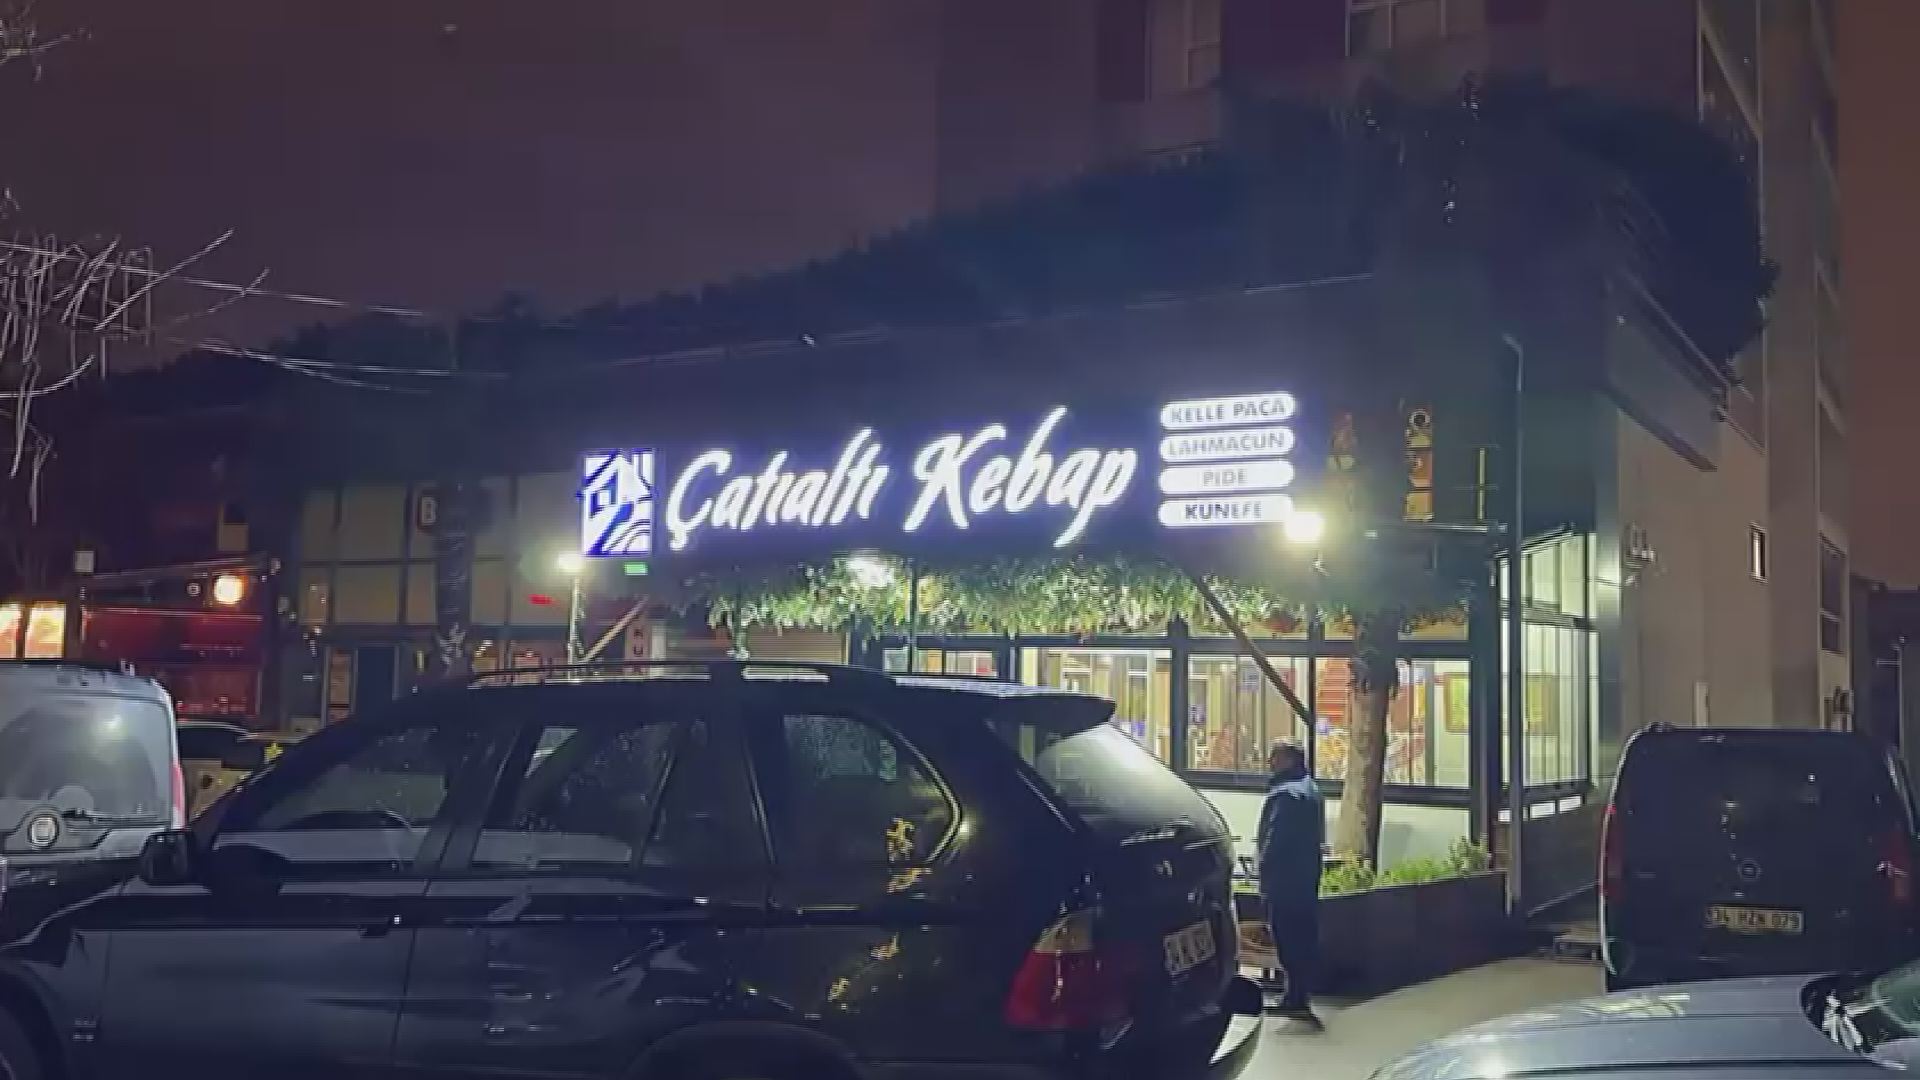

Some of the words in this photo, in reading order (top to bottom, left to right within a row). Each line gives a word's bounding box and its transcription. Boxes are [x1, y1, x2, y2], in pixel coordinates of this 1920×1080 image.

[1170, 404, 1225, 423] KELLE
[1168, 431, 1285, 457] LAHMACUN
[903, 406, 1137, 548] Kebap
